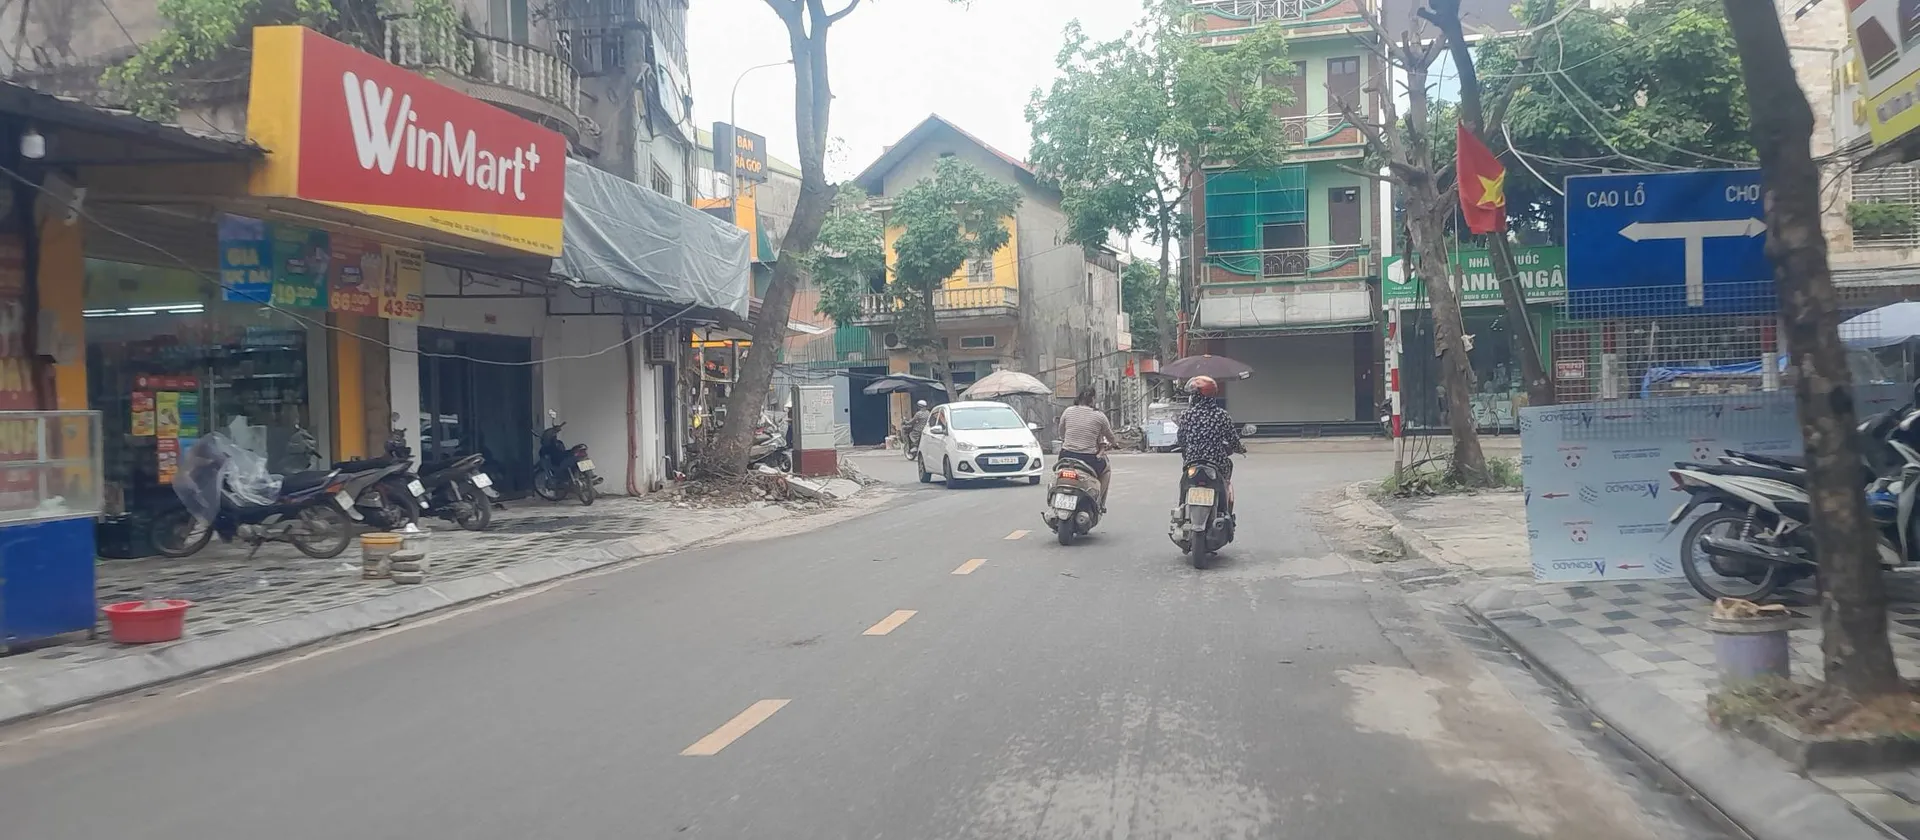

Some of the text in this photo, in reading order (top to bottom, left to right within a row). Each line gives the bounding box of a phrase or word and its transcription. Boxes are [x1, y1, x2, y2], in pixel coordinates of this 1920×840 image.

[343, 71, 540, 201] WinMart+
[737, 134, 754, 152] BÁN
[746, 157, 762, 173] GÓP
[1587, 182, 1646, 208] CAO LỖ
[1725, 184, 1761, 205] CHỢ
[1513, 250, 1540, 266] UỐC
